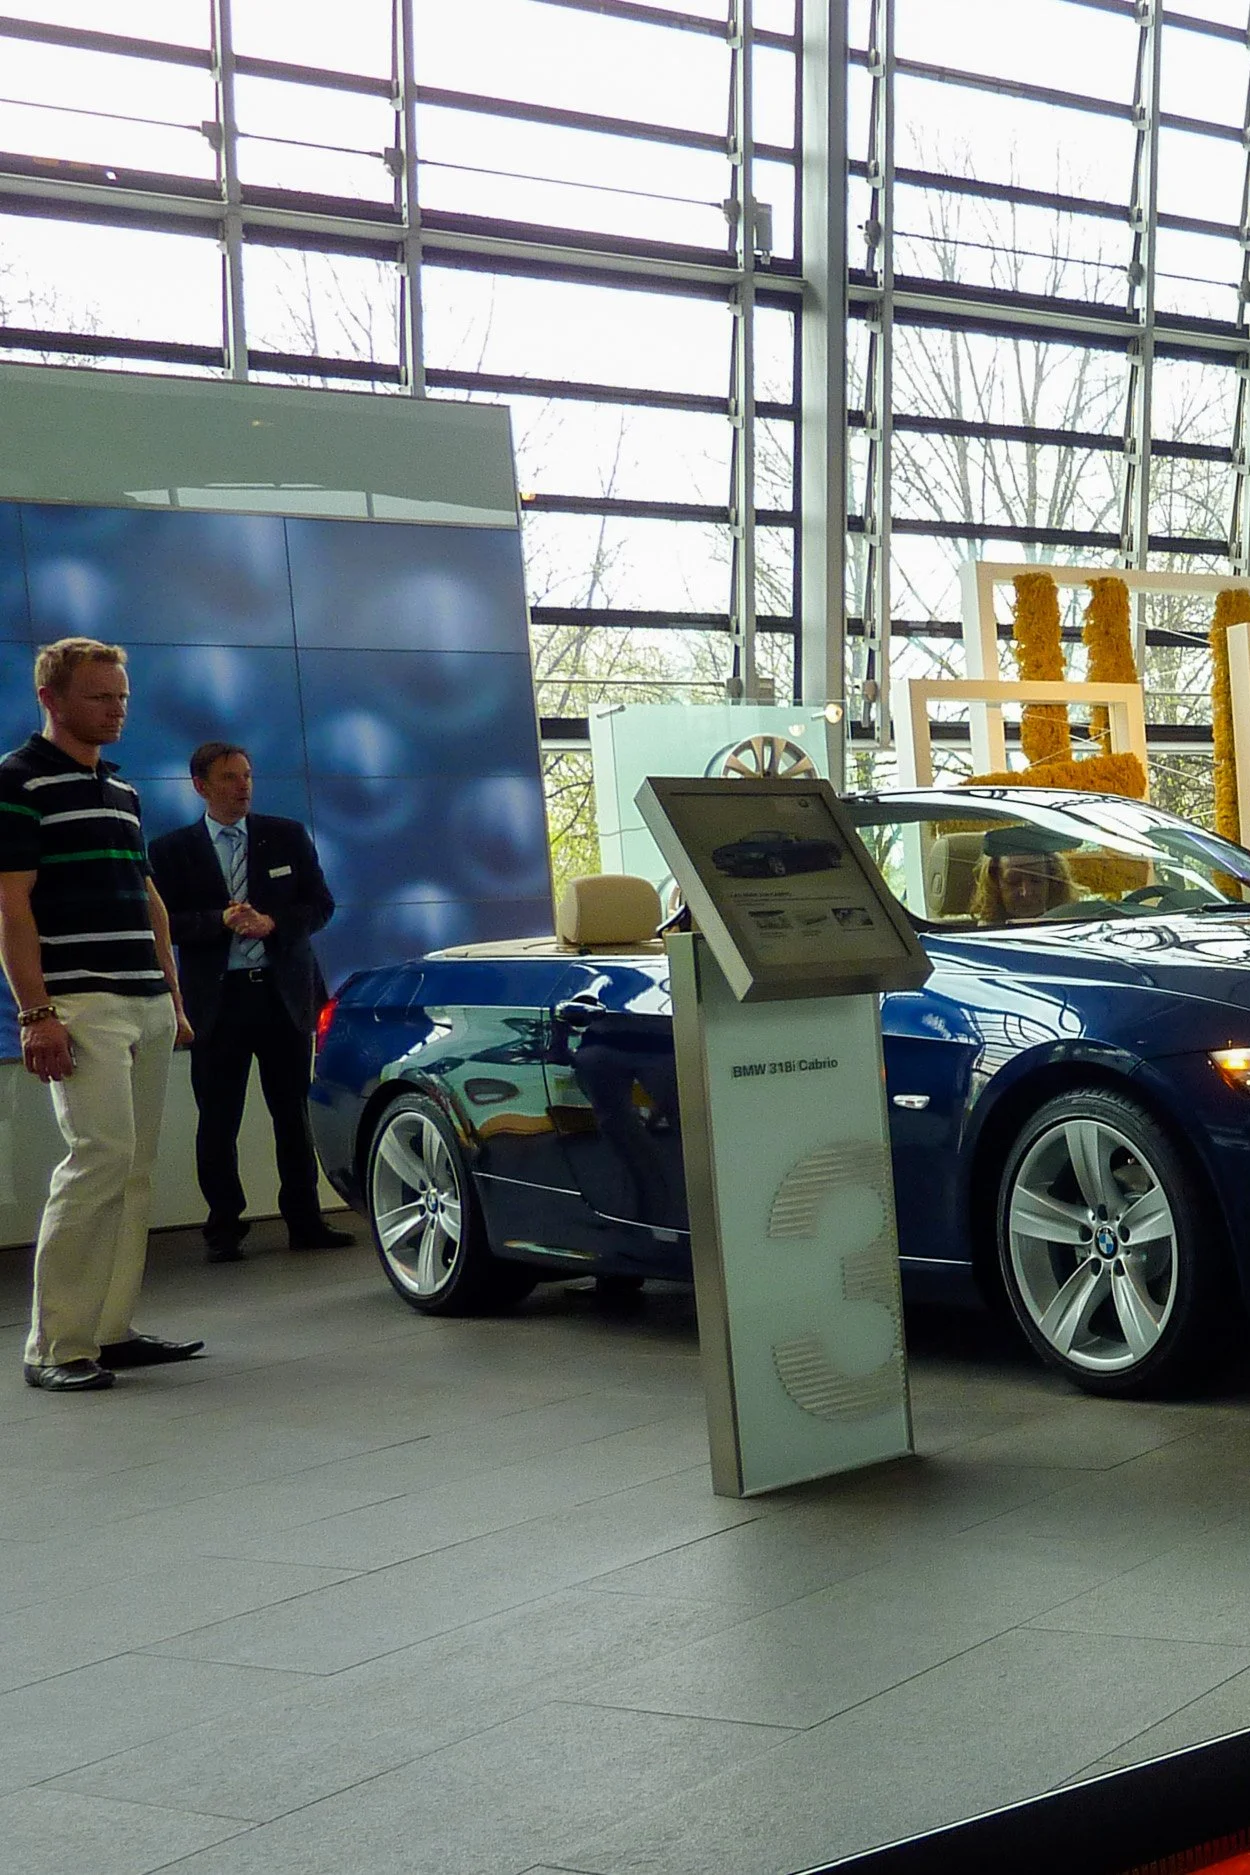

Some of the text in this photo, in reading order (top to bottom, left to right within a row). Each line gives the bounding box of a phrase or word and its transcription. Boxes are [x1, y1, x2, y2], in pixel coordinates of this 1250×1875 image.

[732, 1057, 838, 1078] BMW 318i Cabrio
